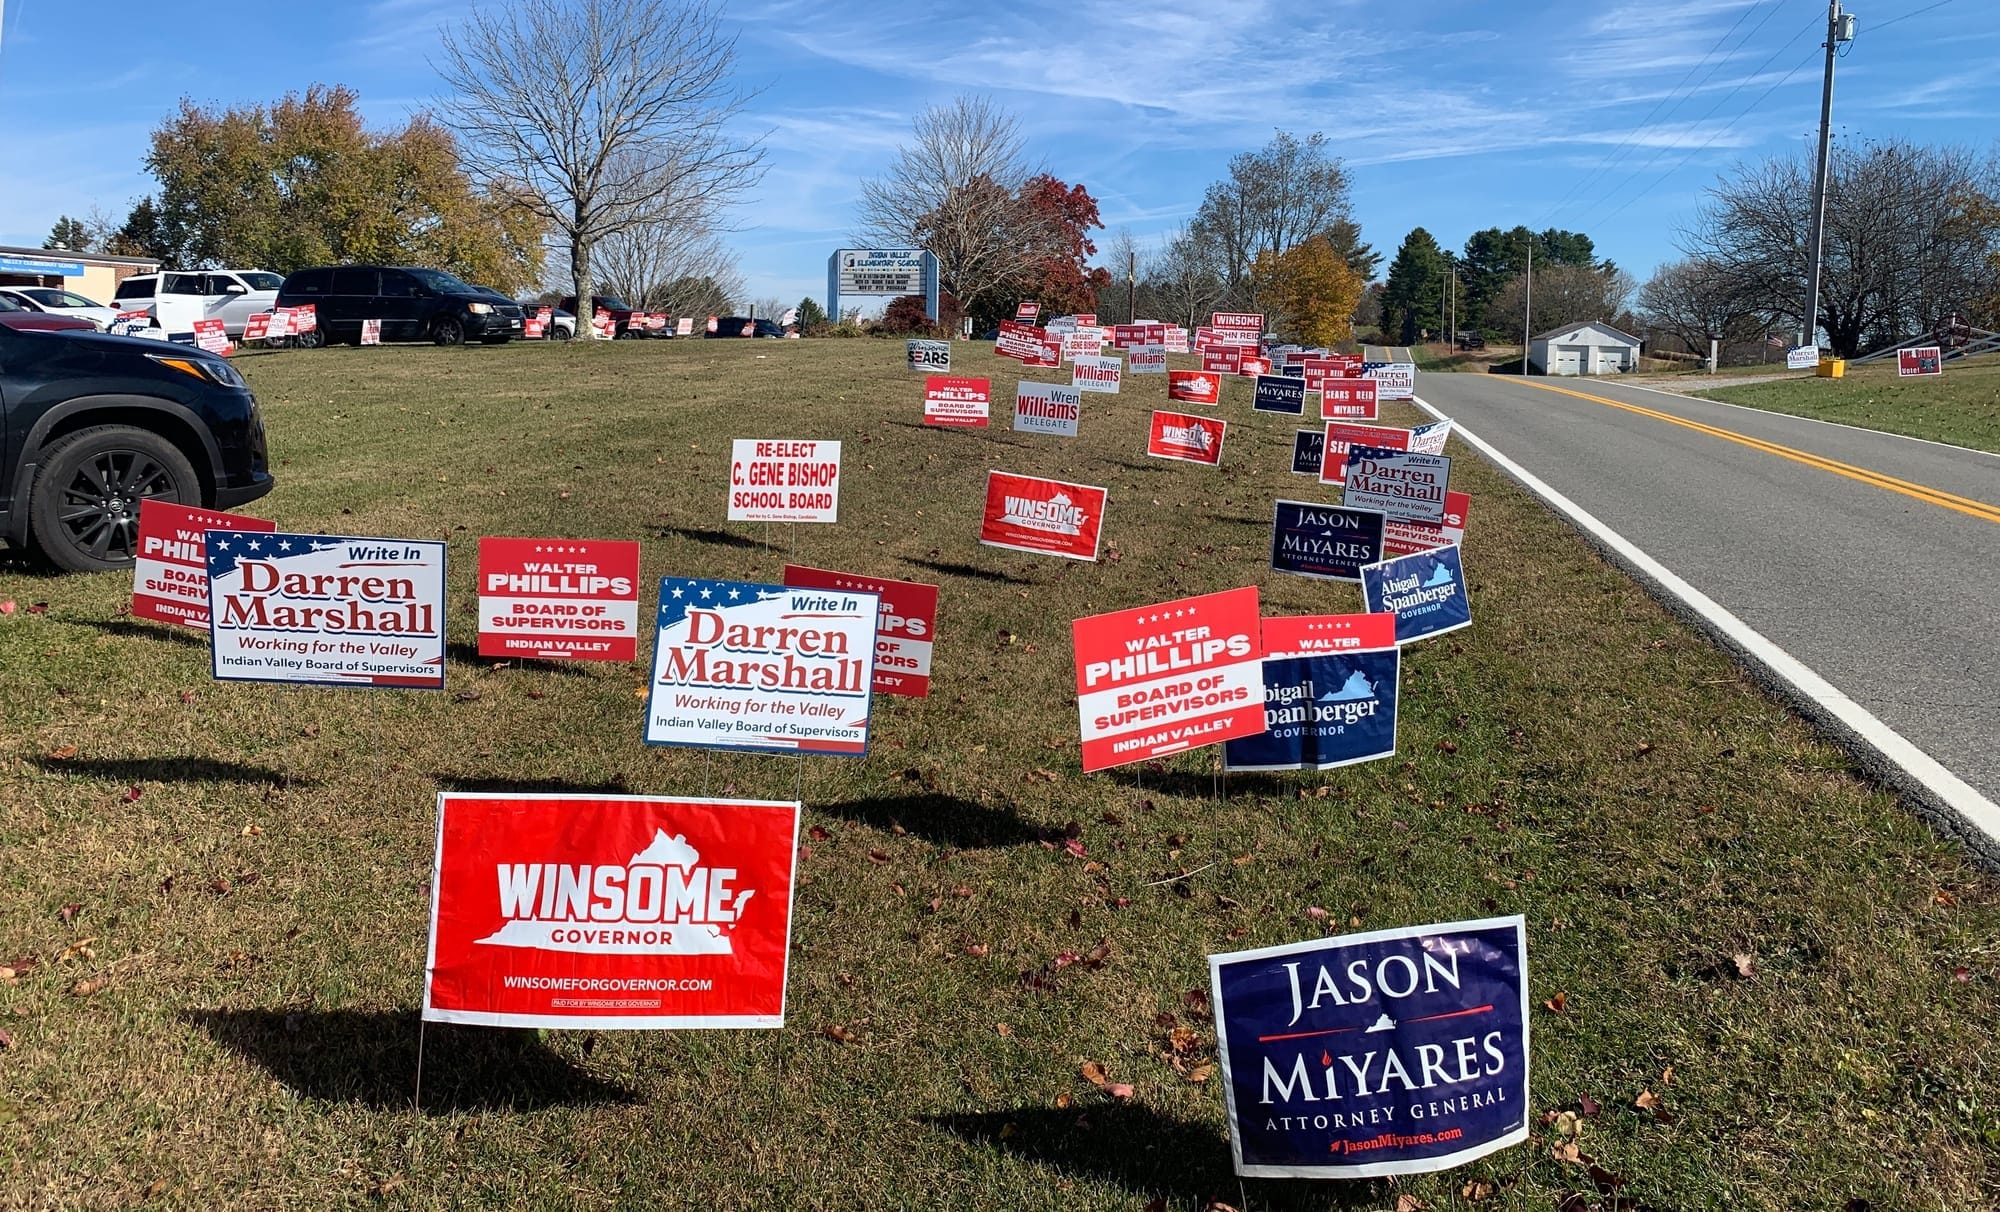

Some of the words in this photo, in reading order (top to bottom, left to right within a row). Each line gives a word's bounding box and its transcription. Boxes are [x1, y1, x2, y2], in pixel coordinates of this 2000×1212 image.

[1216, 315, 1260, 326] WINSOME
[1000, 331, 1042, 344] PHILLIPS
[1011, 329, 1033, 337] WALTER
[1240, 332, 1260, 340] REID
[909, 341, 947, 351] Winsome
[999, 343, 1038, 354] SUPERVISORS
[1071, 341, 1083, 349] GENE
[1084, 341, 1100, 349] BISHOP
[908, 350, 948, 364] SEARS
[1130, 352, 1165, 364] Williams
[1100, 360, 1120, 370] Wren
[1075, 364, 1119, 382] Williams
[1306, 369, 1325, 377] SEARS
[1369, 370, 1408, 378] Darren
[1080, 380, 1112, 388] DELEGATE
[1177, 380, 1212, 390] WINSOME
[928, 390, 986, 400] PHILLIPS
[1051, 390, 1079, 404] Wren
[1325, 390, 1350, 400] SEARS
[1356, 391, 1374, 400] REID
[1018, 395, 1078, 420] Williams
[1334, 406, 1365, 414] MIYARES
[1024, 416, 1068, 428] DELEGATE
[1162, 425, 1212, 444] WINSOME
[756, 443, 816, 458] RE-ELECT
[1408, 456, 1430, 465] Write
[733, 462, 744, 486] C.
[750, 462, 784, 486] GENE
[788, 463, 837, 487] BISHOP
[1360, 460, 1435, 484] Darren
[1349, 474, 1442, 501] Marshall
[734, 492, 784, 508] SCHOOL
[789, 493, 832, 509] BOARD
[1354, 495, 1384, 507] Working
[1385, 498, 1396, 508] for
[1398, 500, 1409, 509] the
[1411, 503, 1433, 513] Valley
[1005, 496, 1084, 526] WINSOME
[1021, 519, 1061, 530] GOVERNOR
[1296, 508, 1360, 530] JASON
[1428, 527, 1442, 535] OF
[349, 546, 400, 560] Write
[403, 547, 421, 560] In
[1282, 553, 1324, 564] ATTORNEY
[523, 562, 598, 574] WALTER
[238, 561, 416, 600] Darren
[488, 574, 632, 595] PHILLIPS
[1381, 573, 1419, 596] Abigail
[791, 596, 838, 611] Write
[841, 597, 858, 611] In
[1382, 583, 1456, 614] Spanberger
[156, 604, 194, 618] INDIAN
[220, 594, 434, 634] Marshall
[512, 604, 578, 616] BOARD
[582, 606, 606, 616] OF
[1401, 603, 1441, 619] GOVERNOR
[492, 616, 626, 631] SUPERVISORS
[684, 610, 848, 654] Darren
[1125, 626, 1210, 653] WALTER
[238, 636, 309, 654] Working
[311, 640, 335, 655] for
[340, 640, 365, 652] the
[370, 643, 418, 658] Valley
[506, 640, 553, 649] INDIAN
[555, 641, 611, 651] VALLEY
[876, 642, 900, 653] OF
[1299, 638, 1361, 649] WALTER
[222, 656, 262, 666] Indian
[264, 657, 302, 669] Valley
[306, 659, 343, 670] Board
[346, 662, 359, 671] of
[362, 662, 435, 674] Supervisors
[1085, 634, 1252, 687] PHILLIPS
[662, 647, 863, 692] Marshall
[1117, 681, 1192, 708] BOARD
[1197, 675, 1225, 691] OF
[1262, 680, 1315, 705] bigail
[675, 694, 741, 715] Working
[744, 699, 766, 715] for
[770, 701, 796, 715] the
[799, 702, 845, 720] Valley
[1094, 687, 1248, 730] SUPERVISORS
[1264, 700, 1379, 731] panberger
[656, 716, 694, 728] Indian
[696, 718, 733, 733] Valley
[736, 721, 772, 733] Board
[774, 723, 788, 734] of
[789, 726, 860, 738] Supervisors
[1274, 725, 1344, 738] GOVERNOR
[1113, 732, 1168, 753] INDIAN
[1170, 717, 1234, 738] VALLEY
[496, 864, 738, 923] WINSOME
[551, 928, 672, 945] GOVERNOR
[504, 976, 713, 991] WINSOMEFORGOVERNOR.COM
[1282, 949, 1460, 1027] JASON
[1266, 1106, 1394, 1131] ATTORNEY
[1410, 1088, 1506, 1119] GENERAL
[1344, 1128, 1463, 1155] JasonMiyares.com
